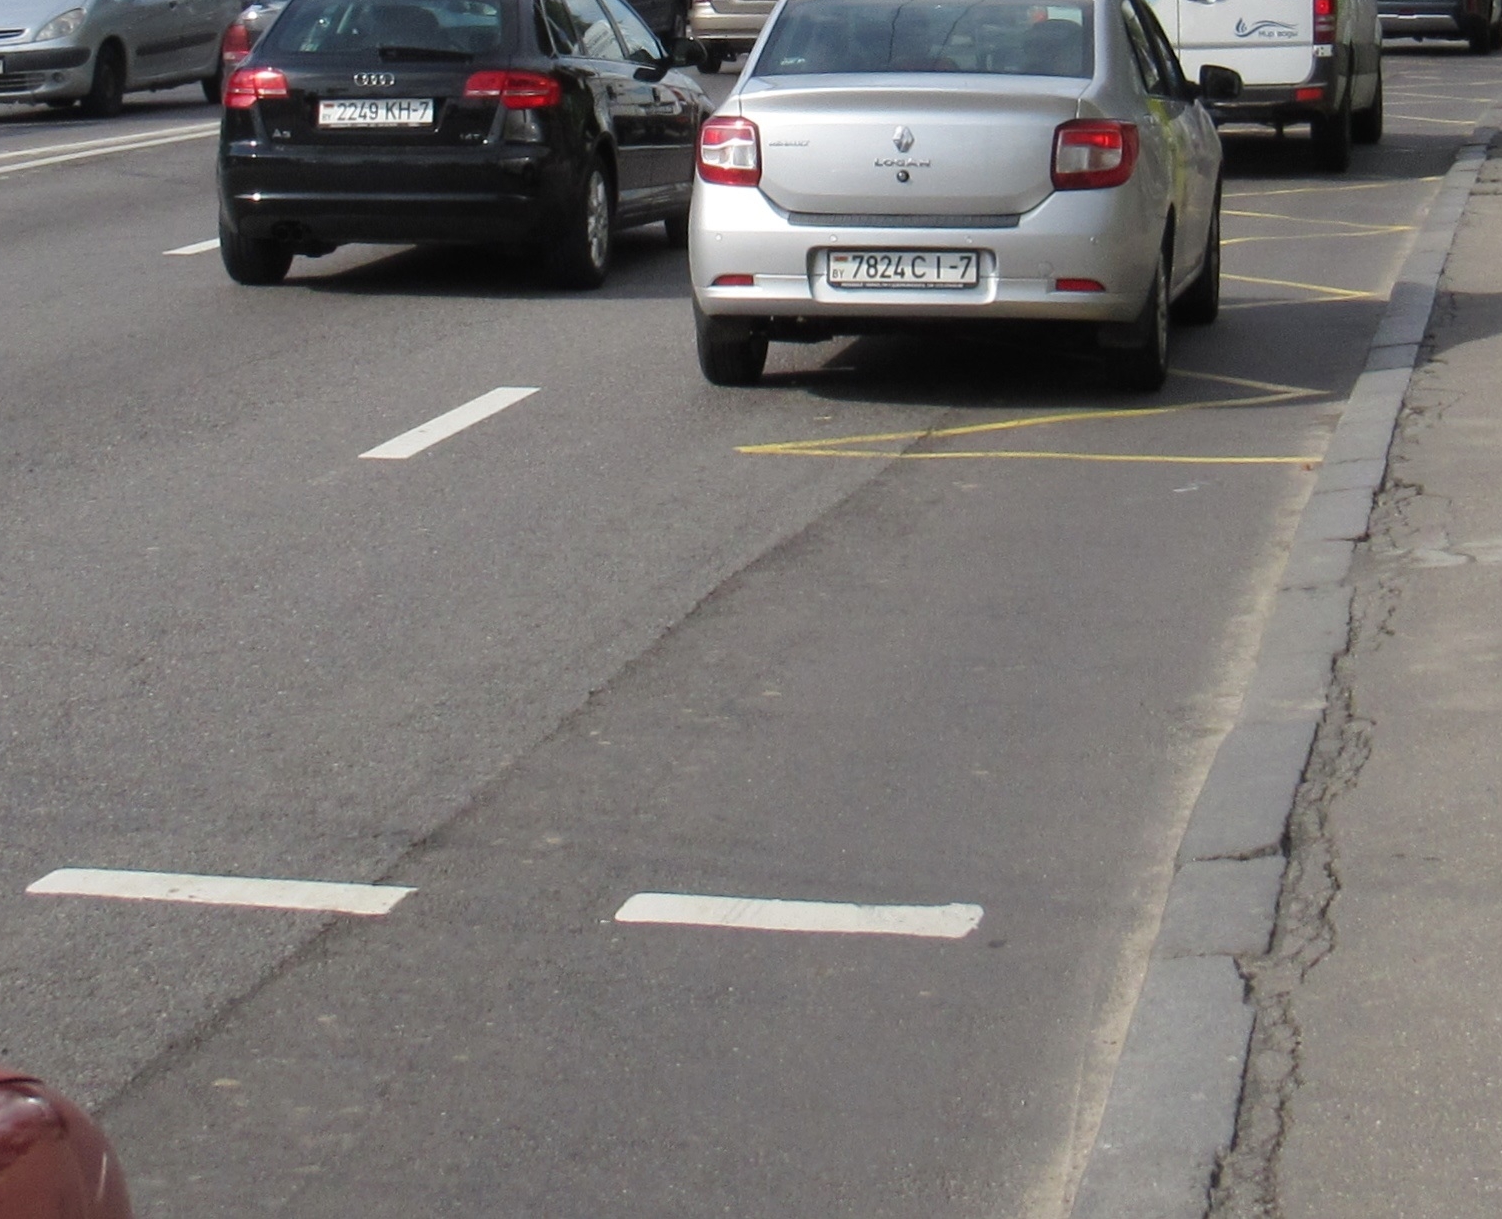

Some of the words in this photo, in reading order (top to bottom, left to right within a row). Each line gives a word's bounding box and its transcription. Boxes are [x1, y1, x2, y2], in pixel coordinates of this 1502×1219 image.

[337, 103, 379, 121] 2249
[385, 102, 429, 121] KH-7
[874, 158, 931, 168] LOGAN
[832, 269, 845, 278] BY
[852, 255, 906, 279] 7824
